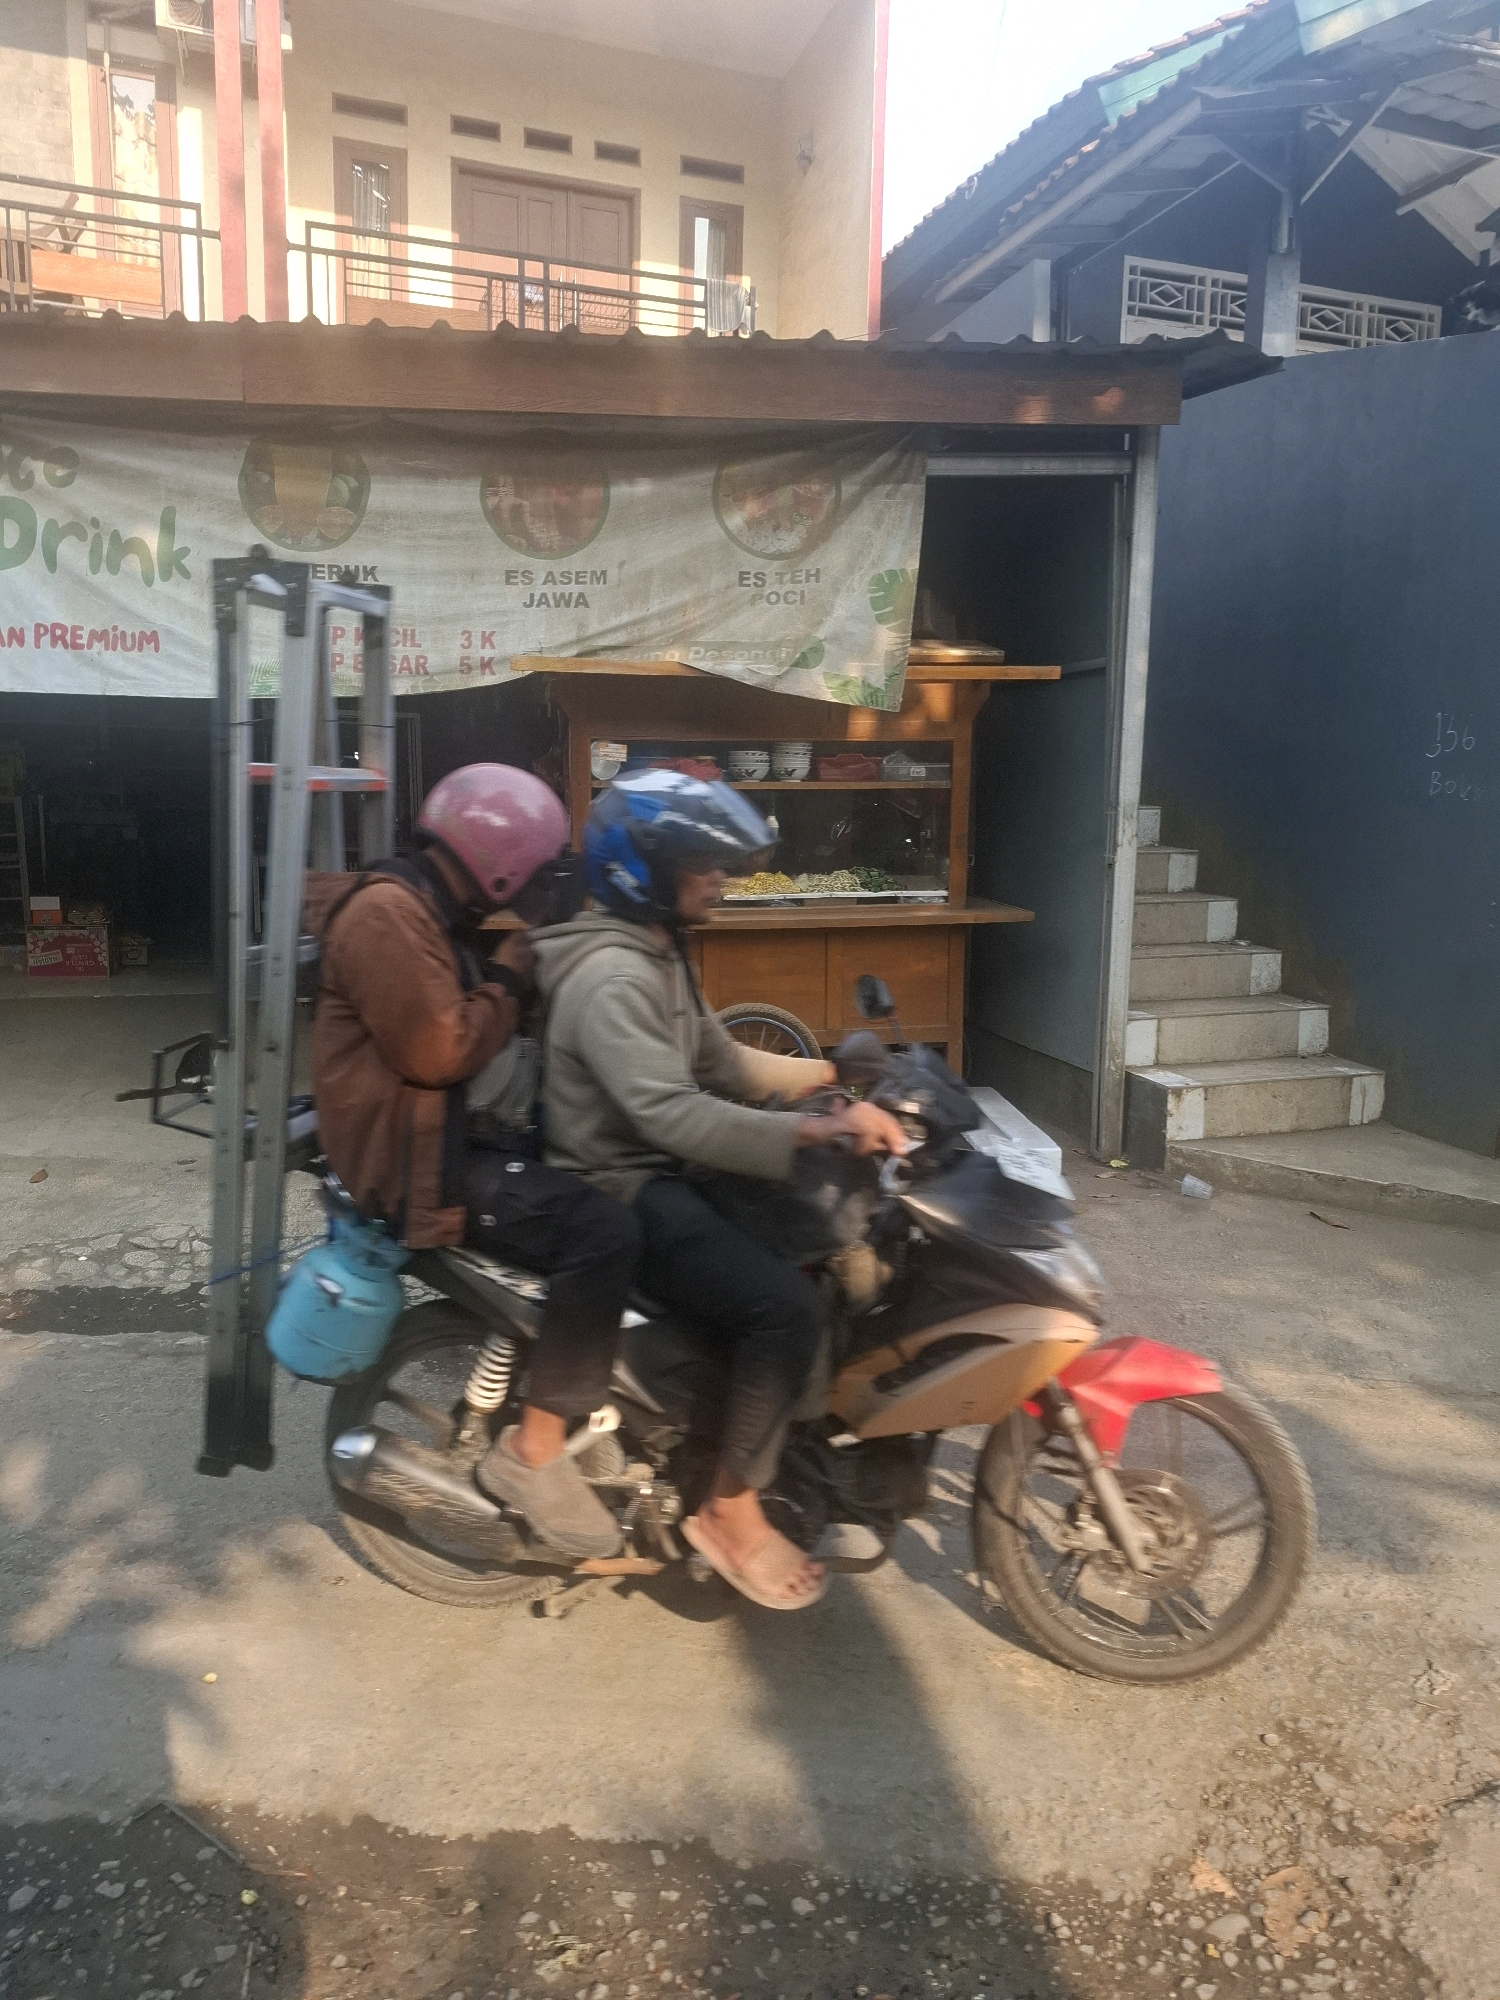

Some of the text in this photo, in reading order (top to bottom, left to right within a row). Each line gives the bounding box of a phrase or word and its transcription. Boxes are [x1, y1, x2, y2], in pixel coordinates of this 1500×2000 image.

[0, 446, 80, 491] ce
[0, 495, 192, 587] Drink
[311, 564, 379, 582] ERUK
[504, 569, 608, 585] ES ASEM
[738, 568, 820, 588] ES TEH
[522, 592, 590, 608] JAWA
[353, 627, 422, 648] KCIL
[460, 630, 472, 649] 3
[480, 631, 496, 649] K
[459, 656, 472, 675] 5
[480, 657, 496, 675] K
